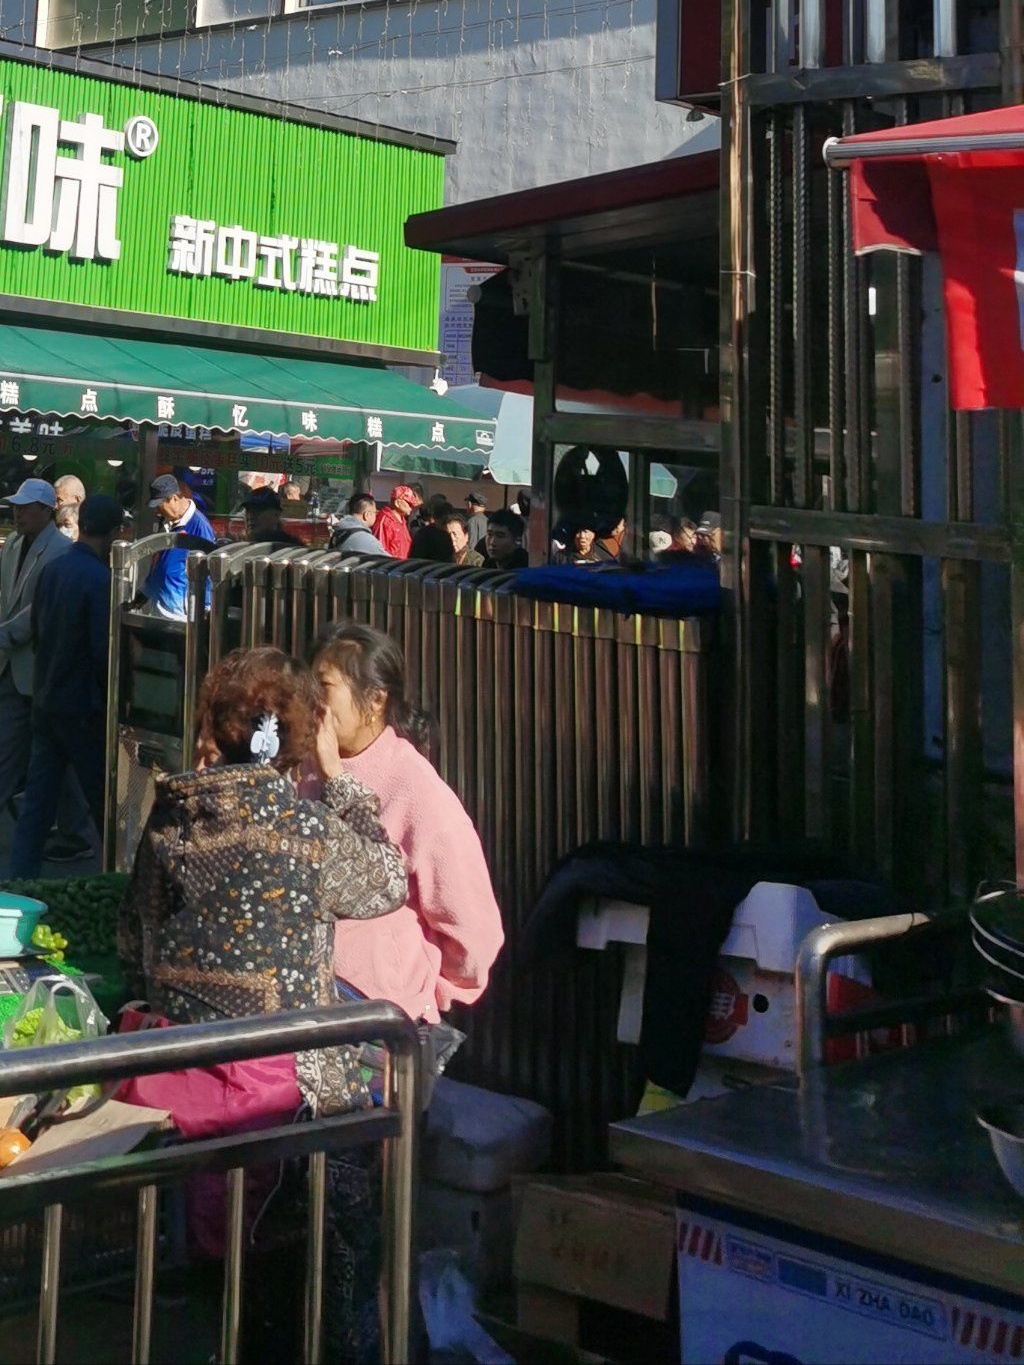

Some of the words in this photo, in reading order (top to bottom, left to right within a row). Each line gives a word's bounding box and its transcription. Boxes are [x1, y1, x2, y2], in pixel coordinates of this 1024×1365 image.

[168, 215, 379, 301] 新中式糕点
